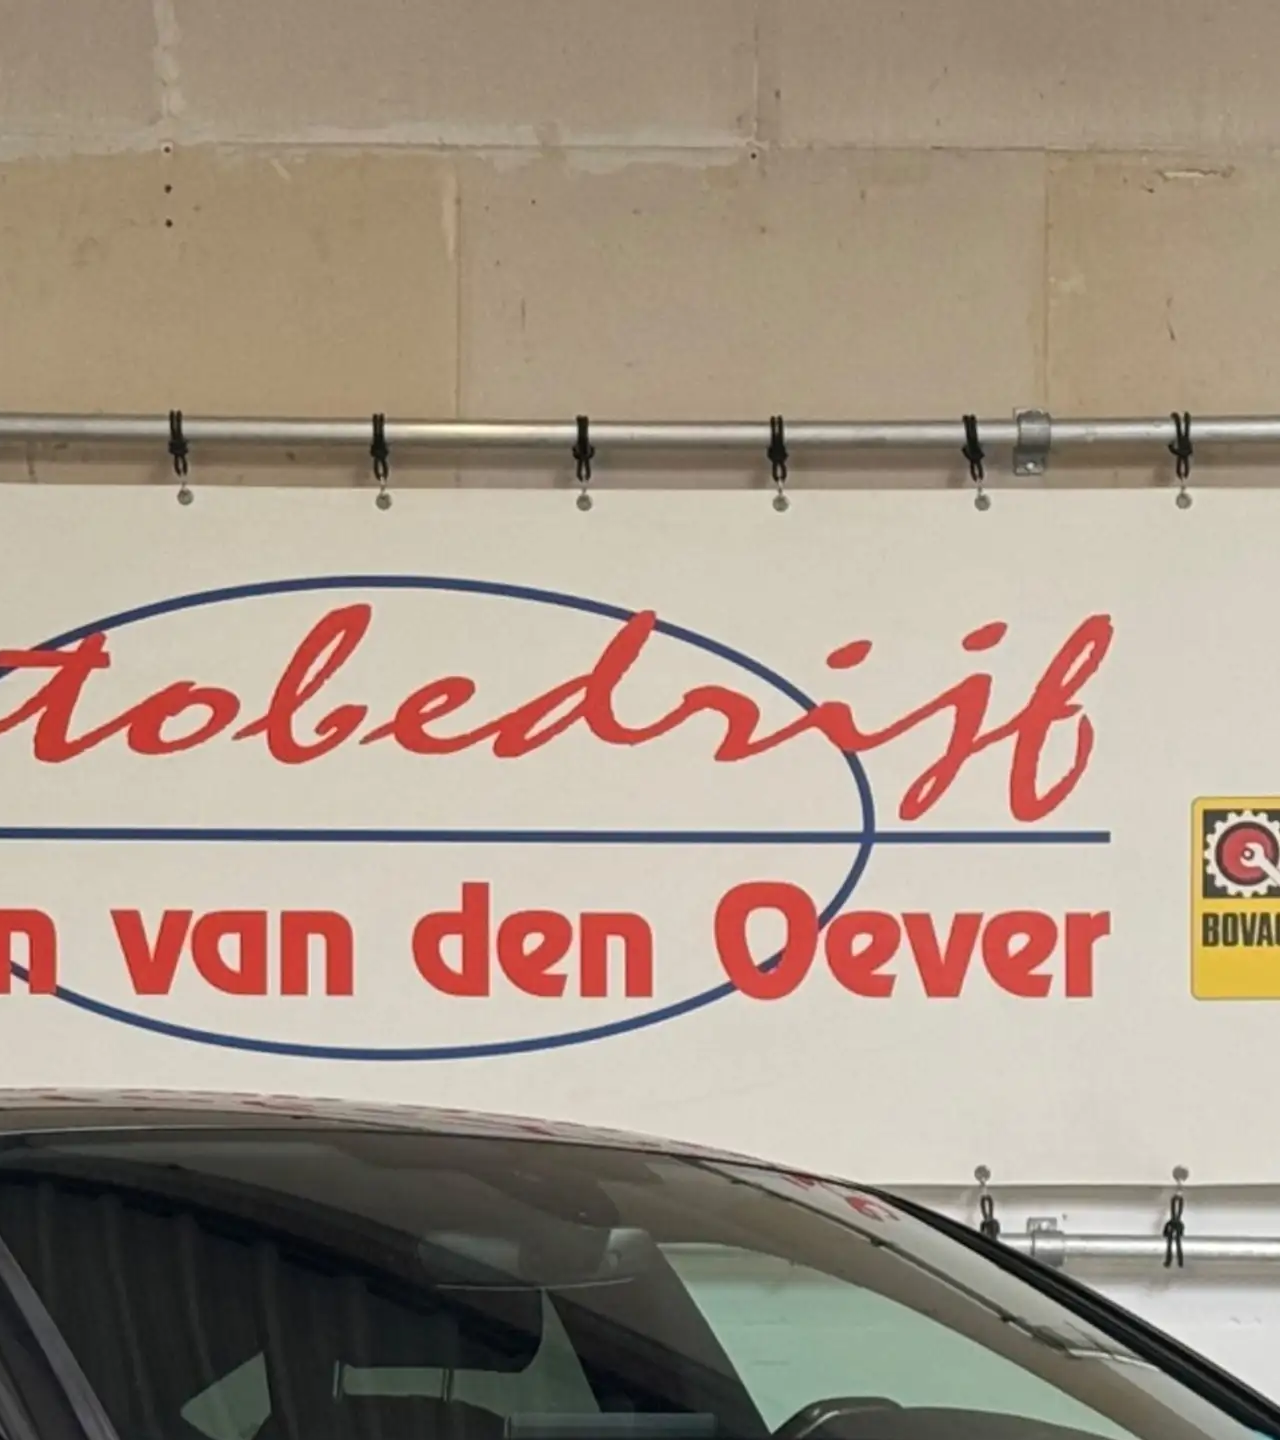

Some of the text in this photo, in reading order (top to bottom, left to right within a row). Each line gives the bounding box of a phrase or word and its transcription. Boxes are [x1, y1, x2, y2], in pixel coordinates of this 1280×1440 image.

[111, 909, 354, 996] van
[411, 881, 654, 998] den
[714, 881, 1111, 1000] Oever
